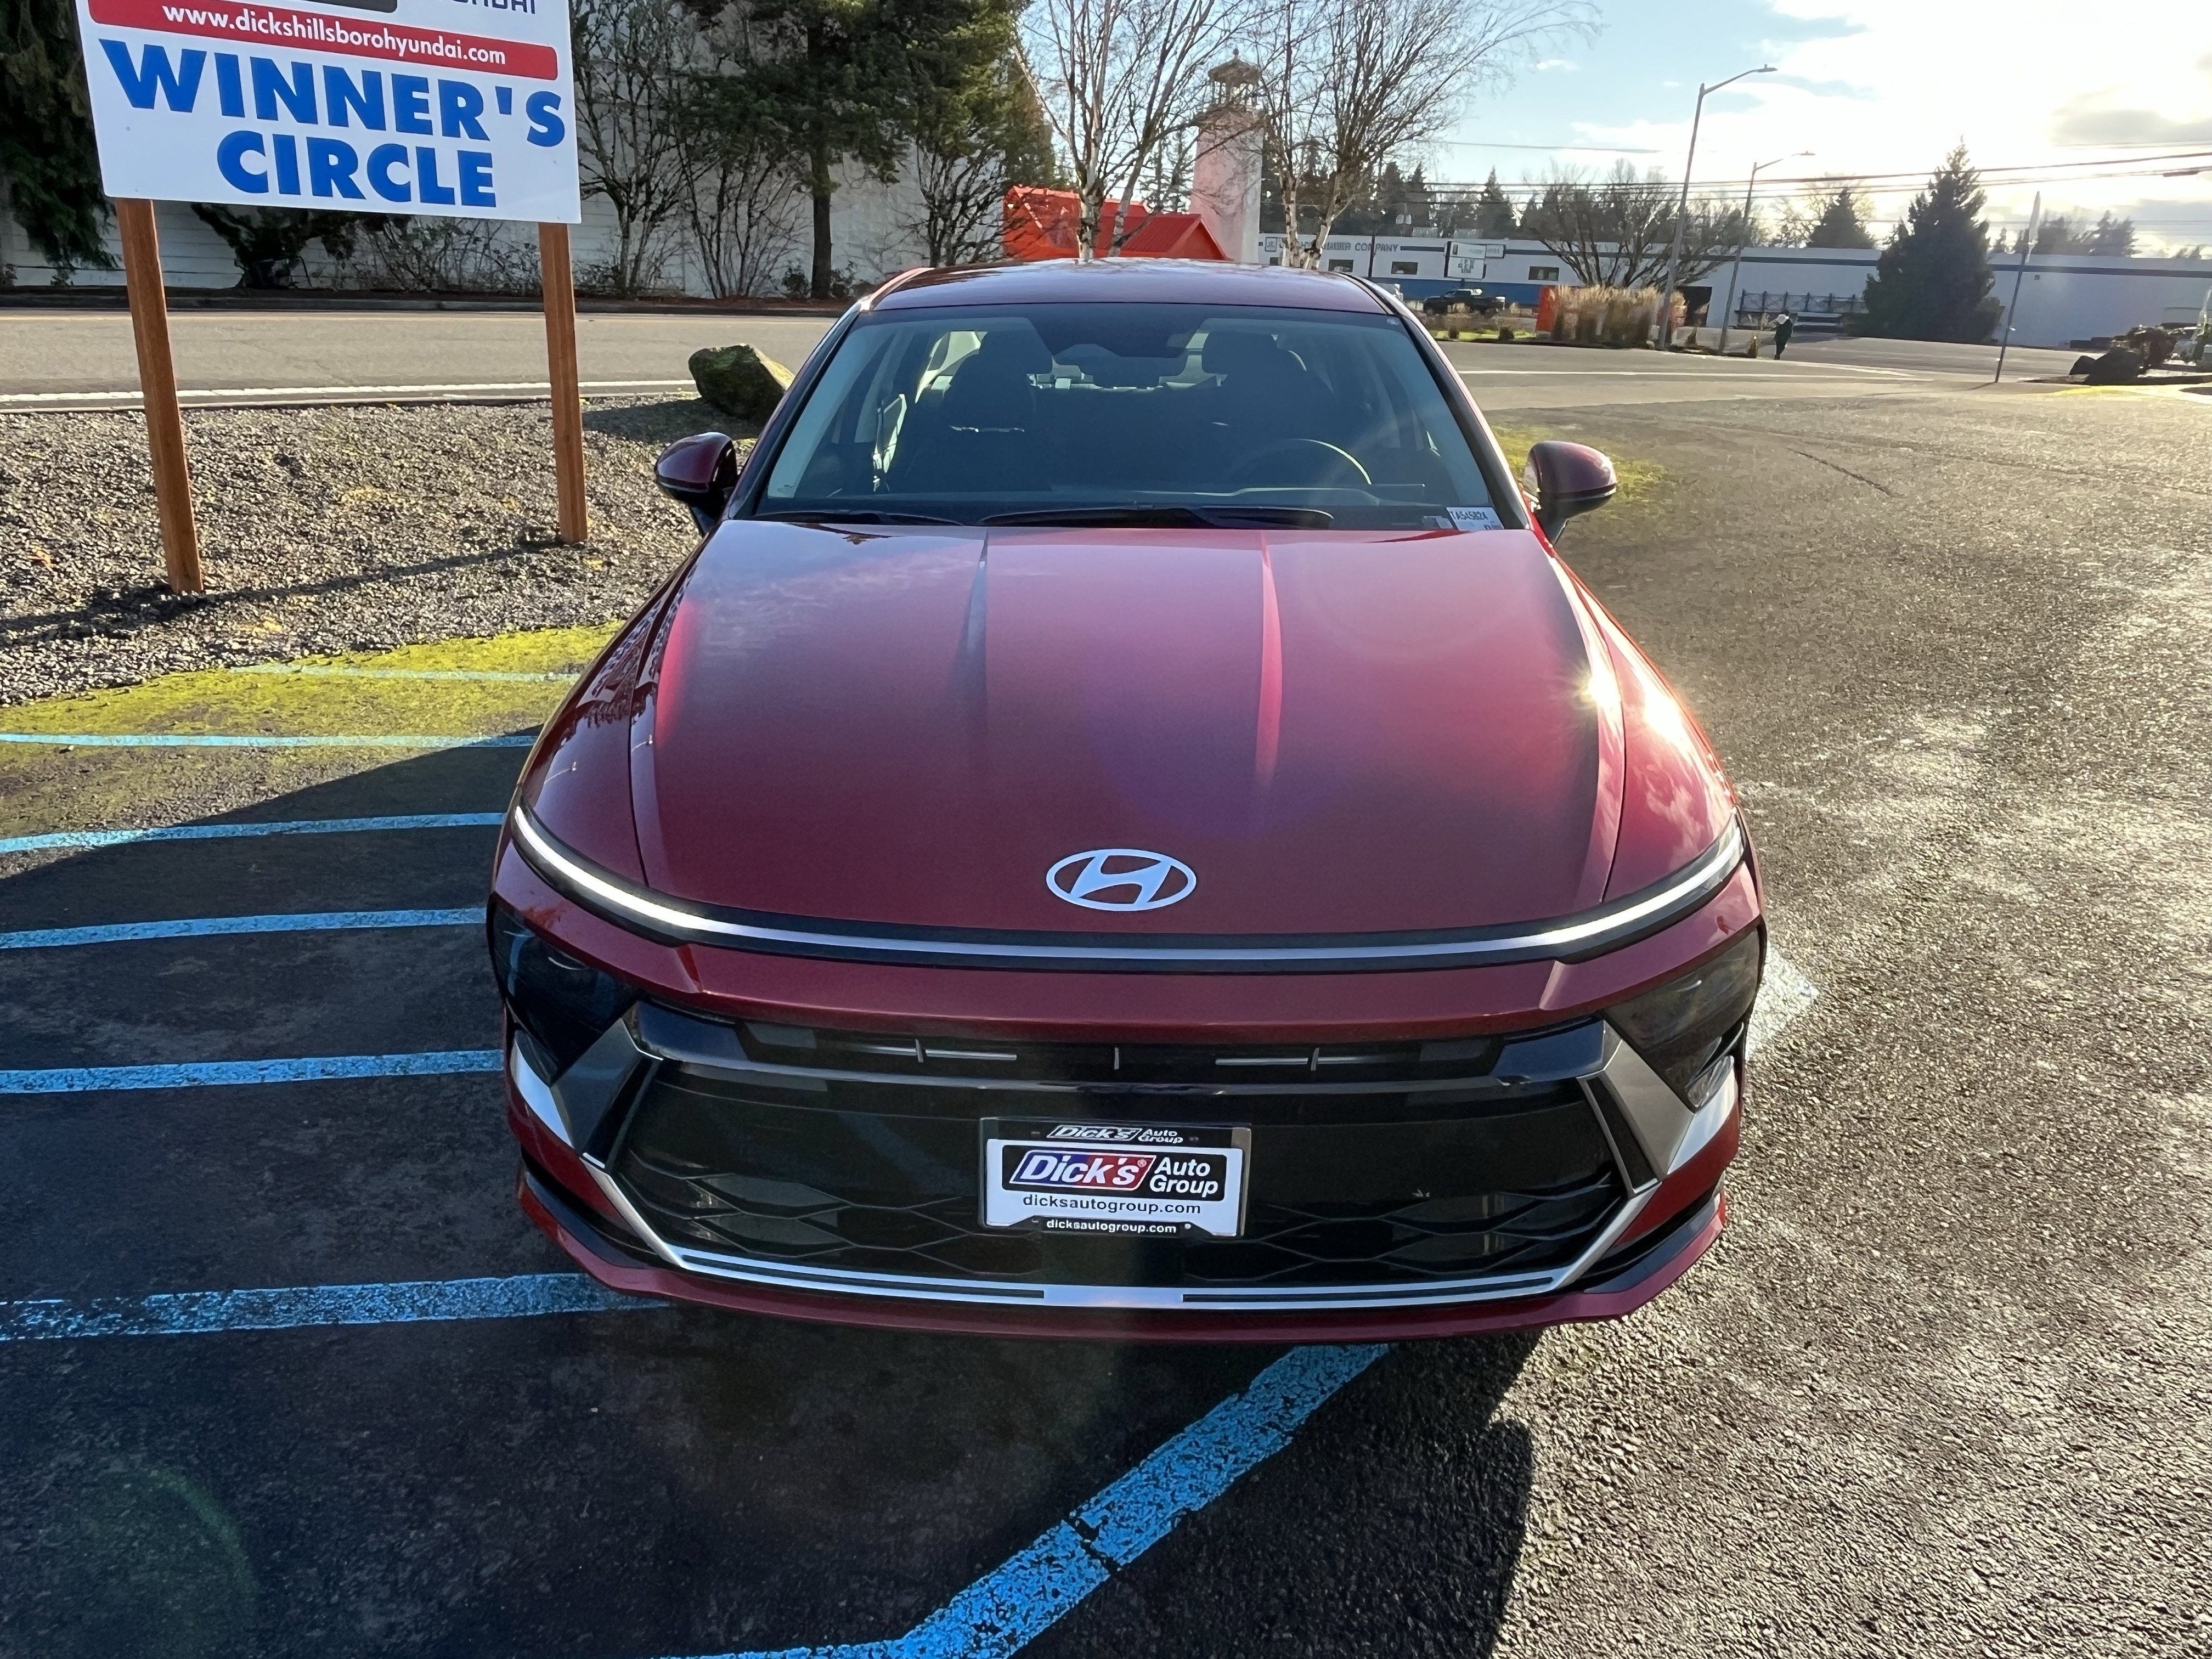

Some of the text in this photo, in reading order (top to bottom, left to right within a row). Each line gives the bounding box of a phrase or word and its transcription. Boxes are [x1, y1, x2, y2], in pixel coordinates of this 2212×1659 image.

[165, 6, 506, 65] www.dickshillsborohyundai.com
[99, 38, 566, 148] WINNER'S
[217, 130, 496, 208] CIRCLE
[1138, 1136, 1184, 1144] Group
[1142, 1128, 1178, 1137] Auto
[1020, 1154, 1211, 1187] Dick's Auto
[1149, 1173, 1218, 1198] Group
[1023, 1194, 1201, 1214] dicksautogroup.com
[1046, 1219, 1177, 1233] dicksautogroup.com
